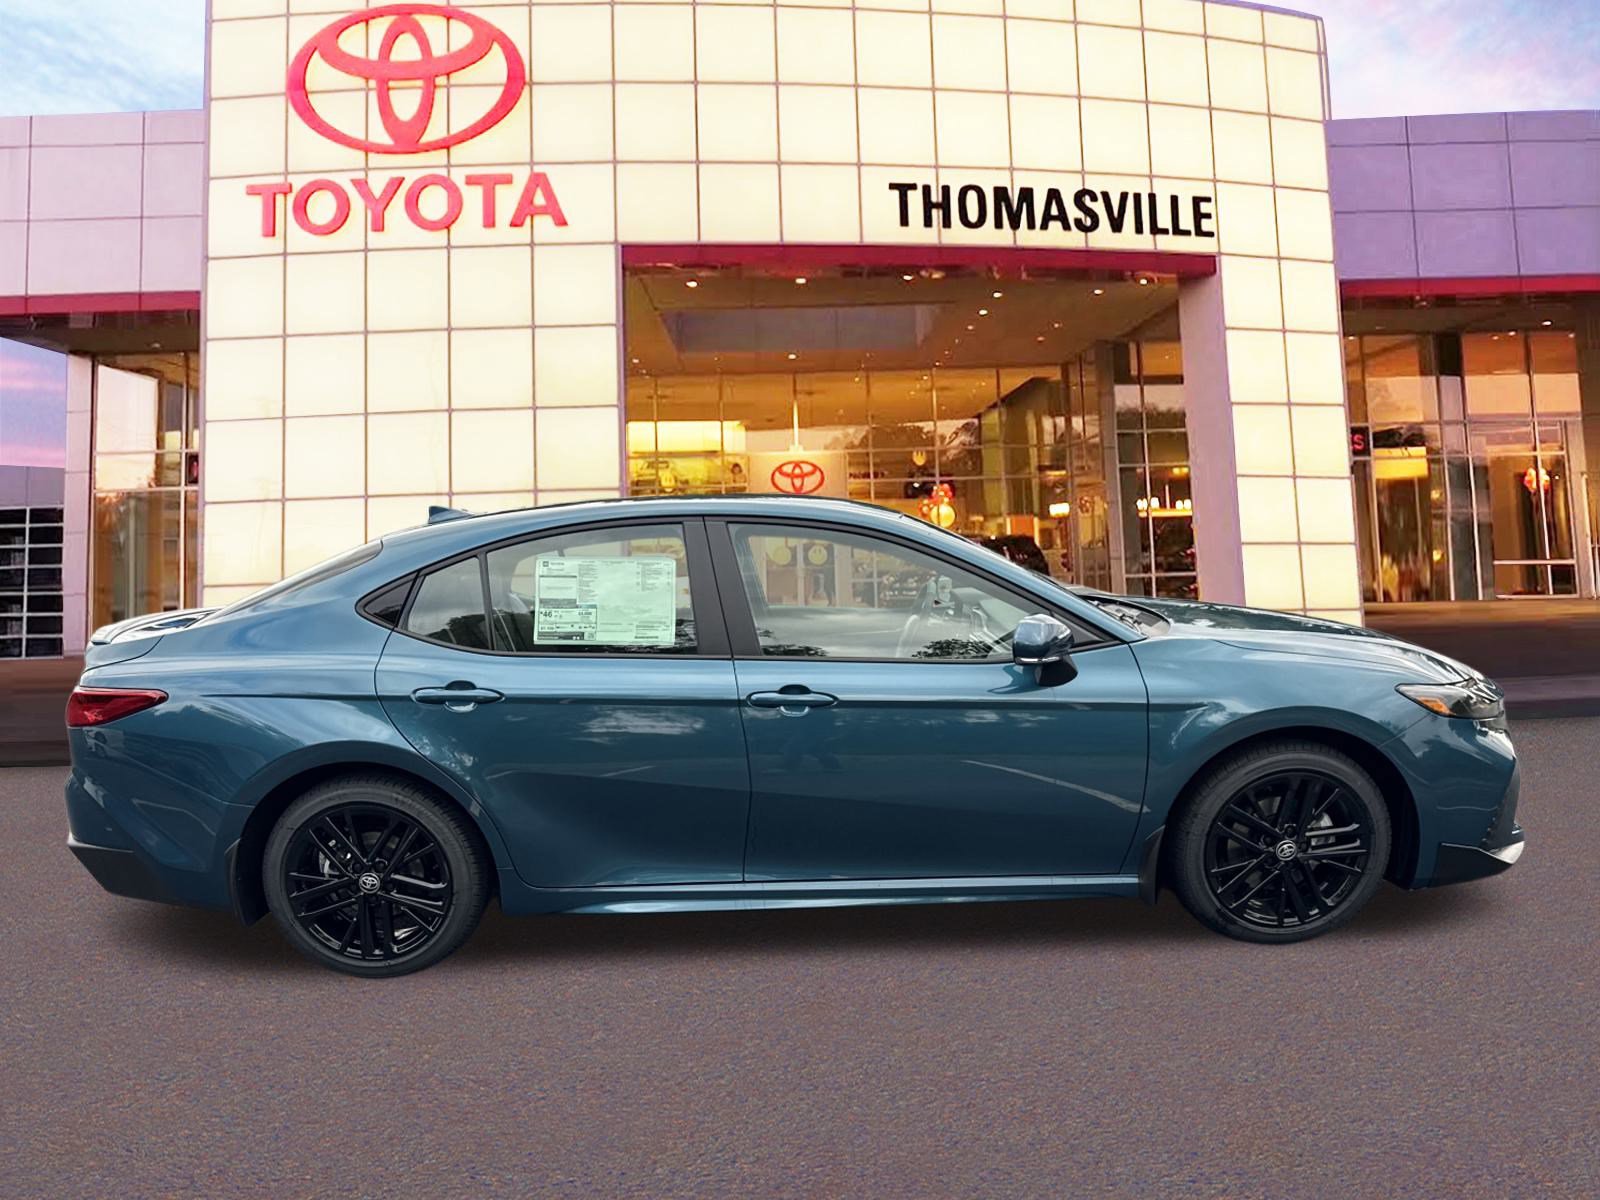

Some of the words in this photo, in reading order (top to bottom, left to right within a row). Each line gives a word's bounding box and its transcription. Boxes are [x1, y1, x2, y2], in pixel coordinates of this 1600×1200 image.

[246, 172, 568, 237] TOYOTA
[889, 183, 1215, 237] THOMASVILLE
[1352, 434, 1365, 450] S
